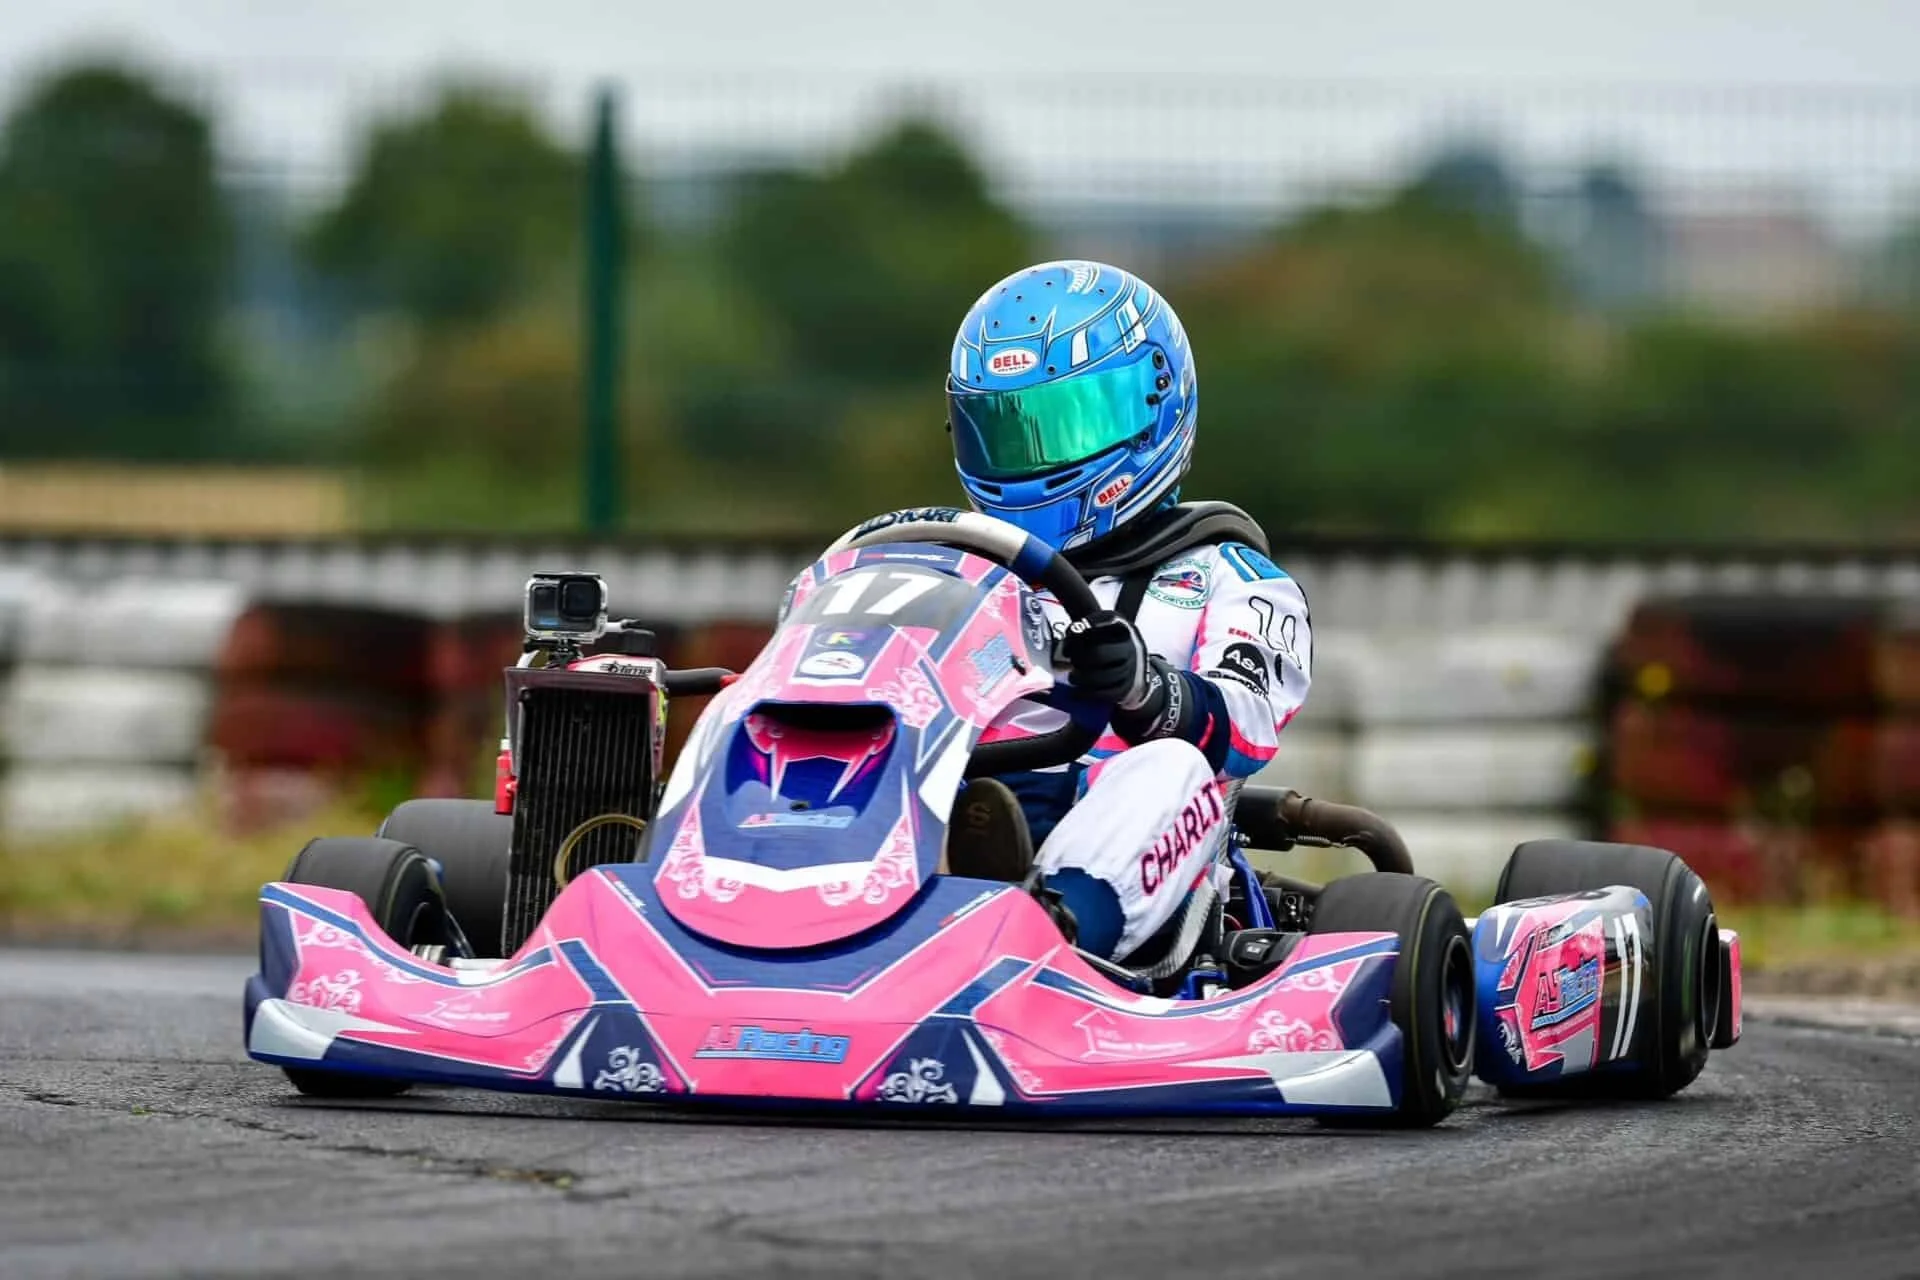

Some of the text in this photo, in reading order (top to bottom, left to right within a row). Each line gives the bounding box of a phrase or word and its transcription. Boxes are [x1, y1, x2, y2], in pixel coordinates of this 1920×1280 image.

[993, 353, 1031, 369] BELL
[1097, 478, 1130, 504] BELL
[822, 571, 944, 615] 17
[1161, 672, 1182, 736] parco
